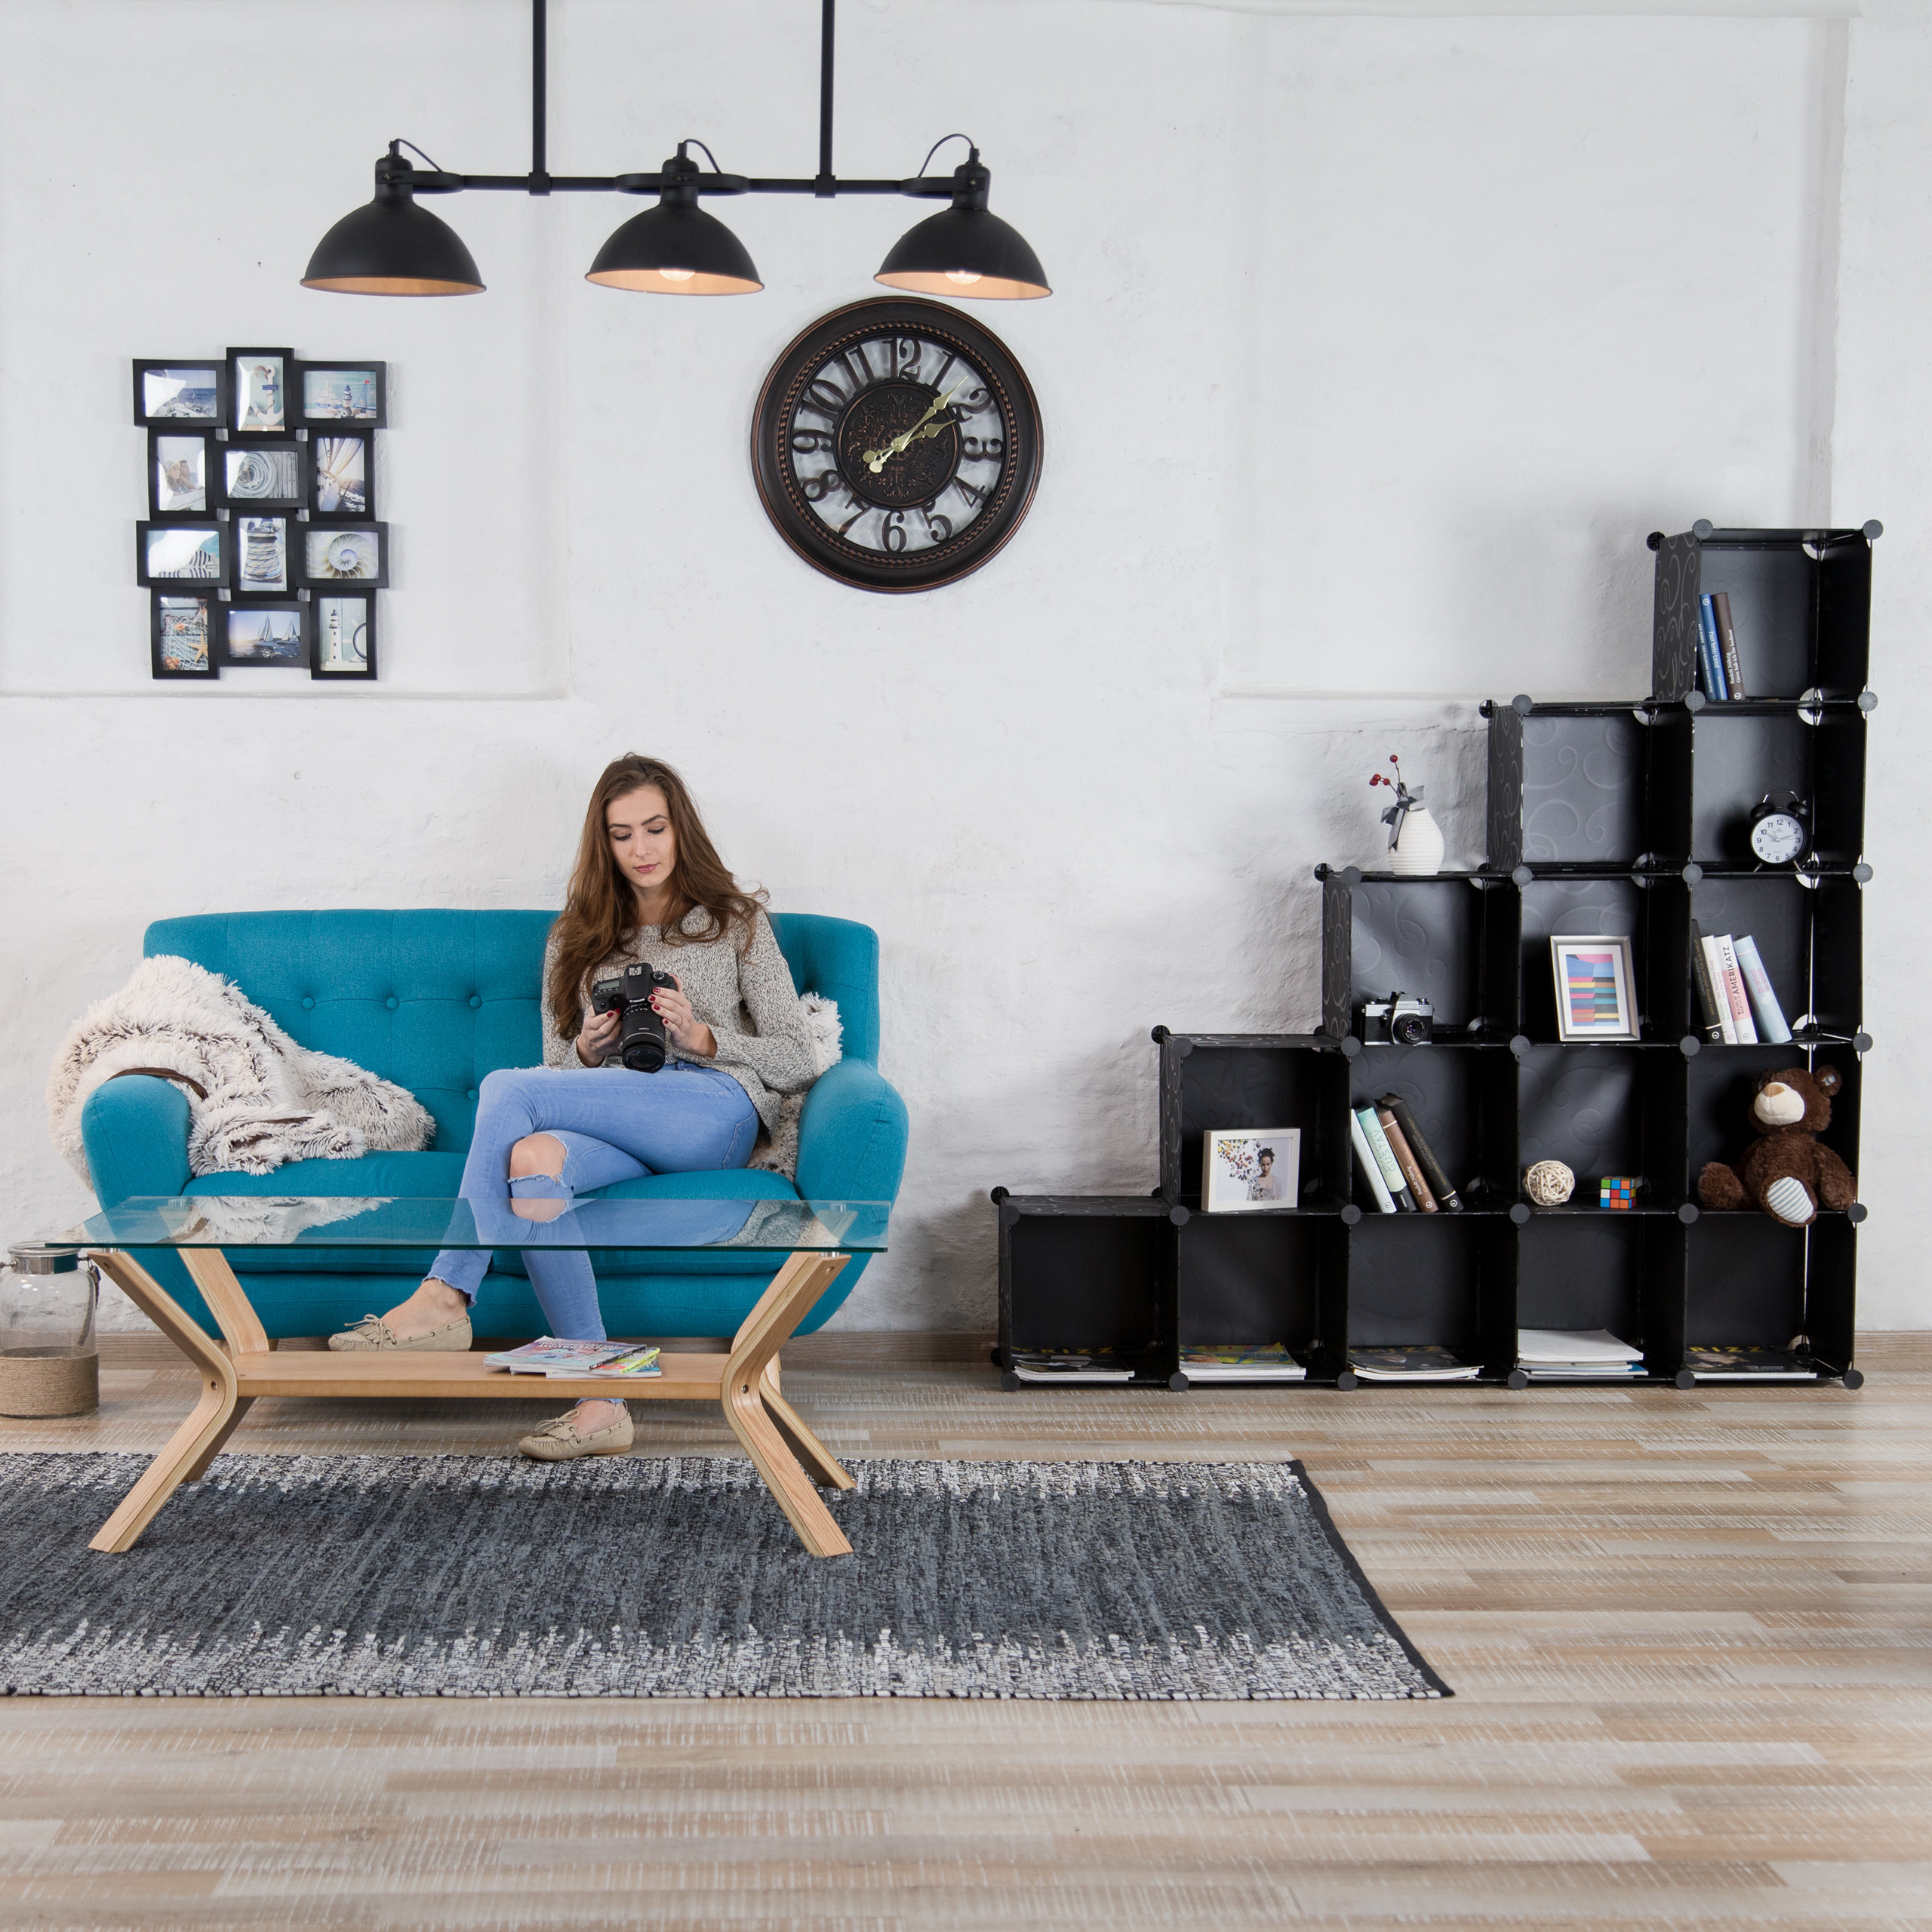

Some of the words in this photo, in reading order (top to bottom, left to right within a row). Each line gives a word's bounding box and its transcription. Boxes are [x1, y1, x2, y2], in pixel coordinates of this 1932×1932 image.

[834, 345, 876, 393] 11
[883, 337, 921, 381] 12
[931, 350, 958, 389] 1
[799, 378, 848, 429] 10
[951, 387, 992, 423] 2
[792, 429, 833, 454] 9
[962, 436, 1003, 462] 3
[801, 469, 842, 503] 8
[953, 475, 992, 511] 4
[838, 496, 871, 536] 7
[882, 510, 906, 552] 6
[921, 500, 952, 543] 5
[1723, 946, 1740, 995] AMERIKATZ
[1374, 1130, 1396, 1172] GUSTAV
[1413, 1180, 1423, 1195] Rudolf
